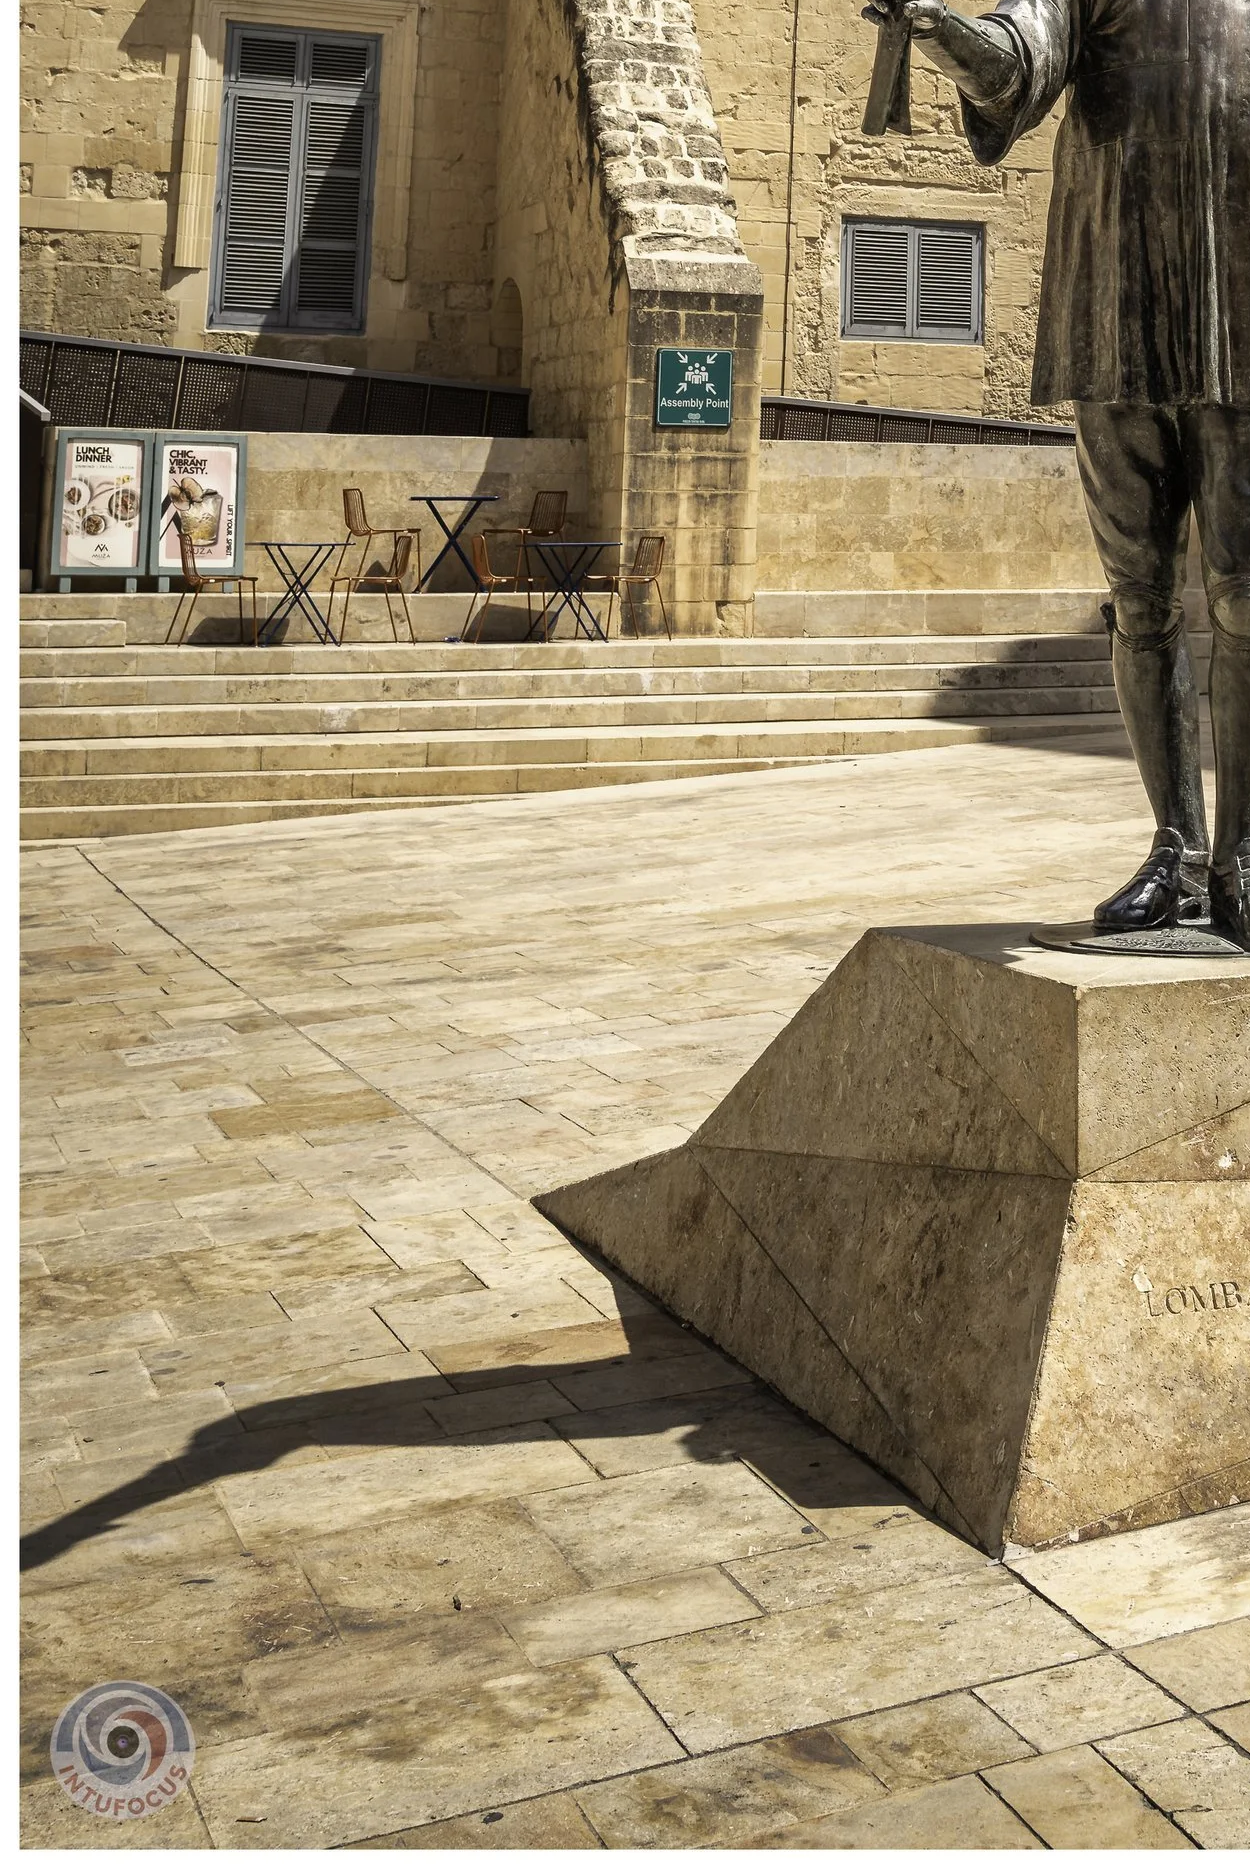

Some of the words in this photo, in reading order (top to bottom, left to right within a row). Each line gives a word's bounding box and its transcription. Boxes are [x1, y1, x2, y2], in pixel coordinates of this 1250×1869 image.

[660, 397, 704, 410] Assembly
[706, 398, 729, 409] Point
[76, 446, 110, 455] LUNCH
[169, 449, 196, 460] CHIC,
[75, 454, 113, 463] DINNER
[169, 458, 208, 467] VIBRANT
[169, 466, 177, 474] &
[177, 467, 208, 475] TASTY.
